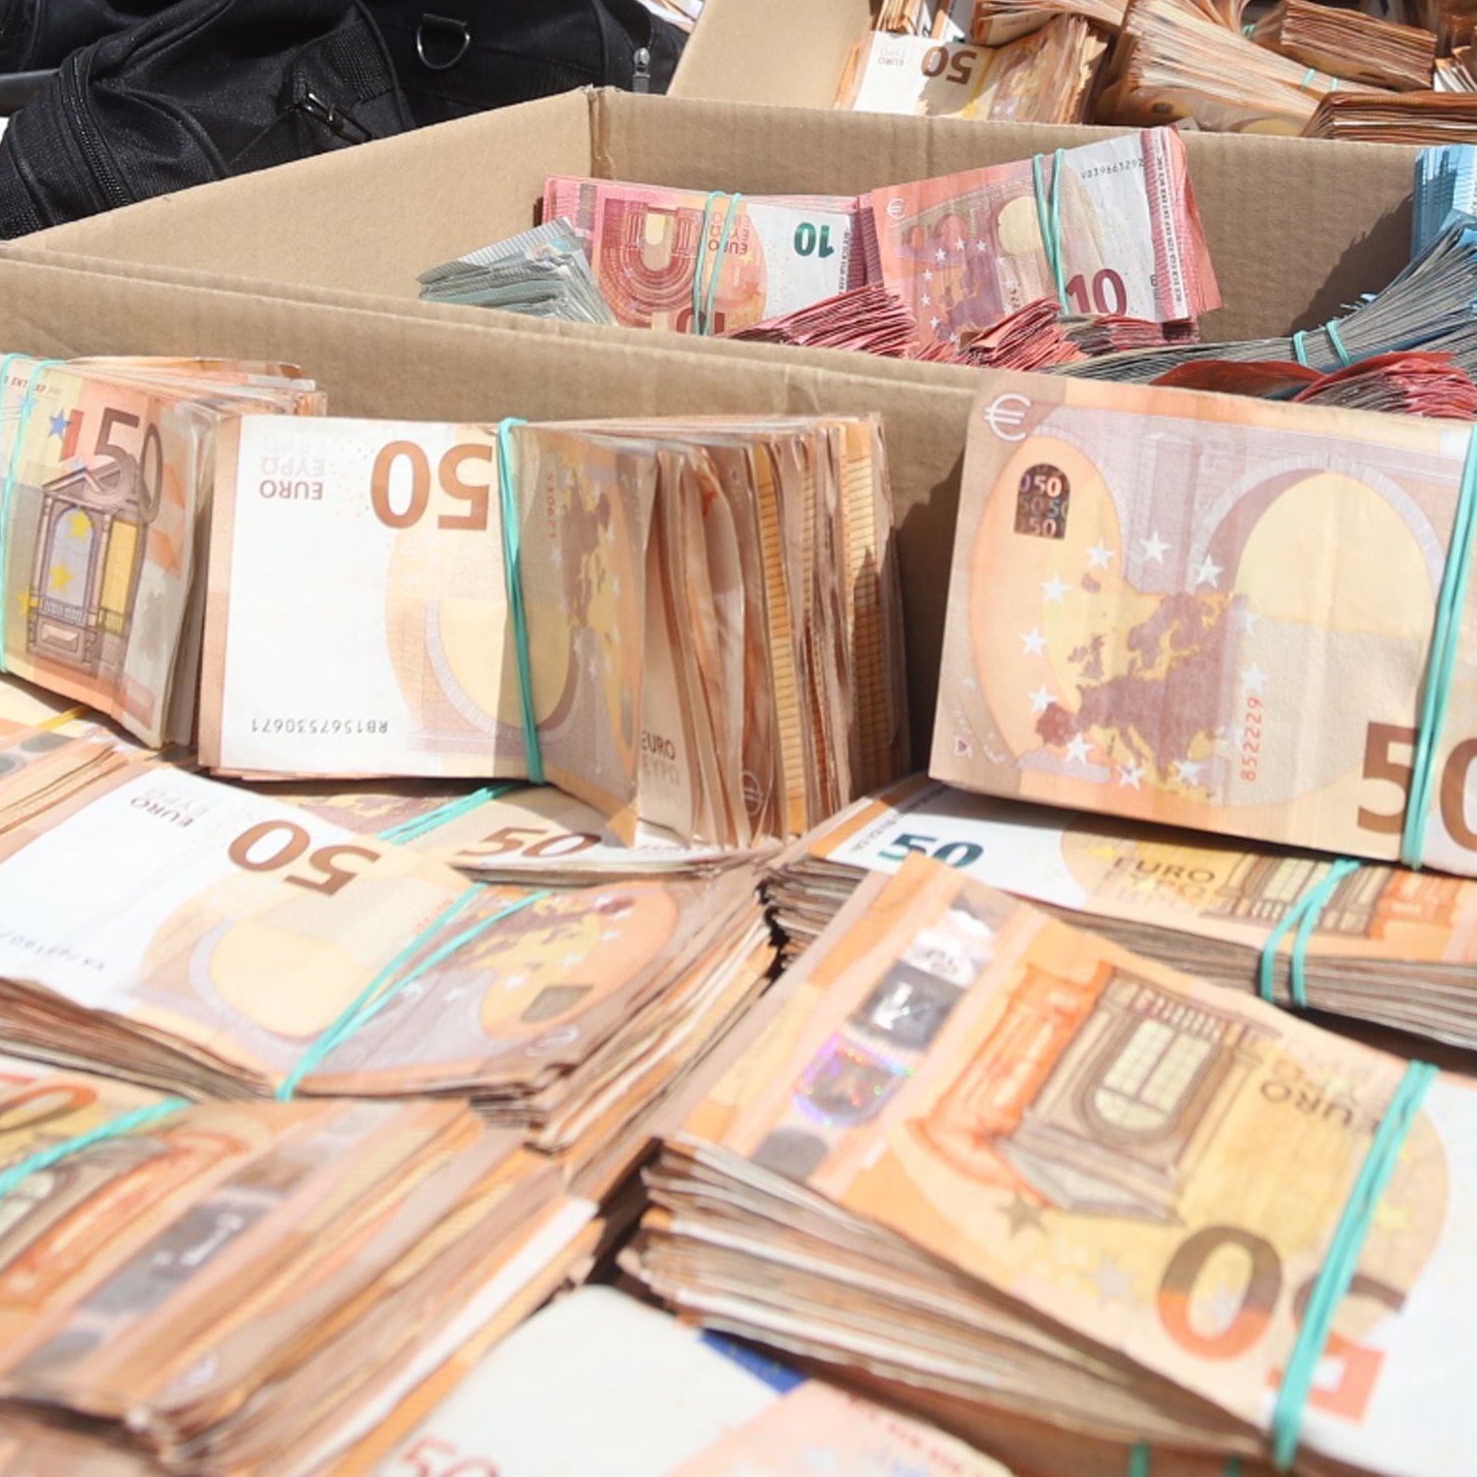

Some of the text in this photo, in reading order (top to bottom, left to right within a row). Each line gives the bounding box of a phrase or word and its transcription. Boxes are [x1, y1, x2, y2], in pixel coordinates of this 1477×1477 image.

[921, 46, 977, 86] 50
[708, 238, 749, 256] EUO
[794, 222, 835, 259] 10
[1065, 268, 1127, 316] 10
[259, 479, 324, 501] EURO
[371, 440, 494, 532] 50
[251, 718, 389, 736] RB1567530671
[1240, 695, 1265, 783] 852229
[227, 819, 383, 897] 50
[461, 826, 603, 860] 50
[877, 833, 985, 870] 50
[1114, 856, 1216, 886] EURO
[1157, 1222, 1408, 1426] 50
